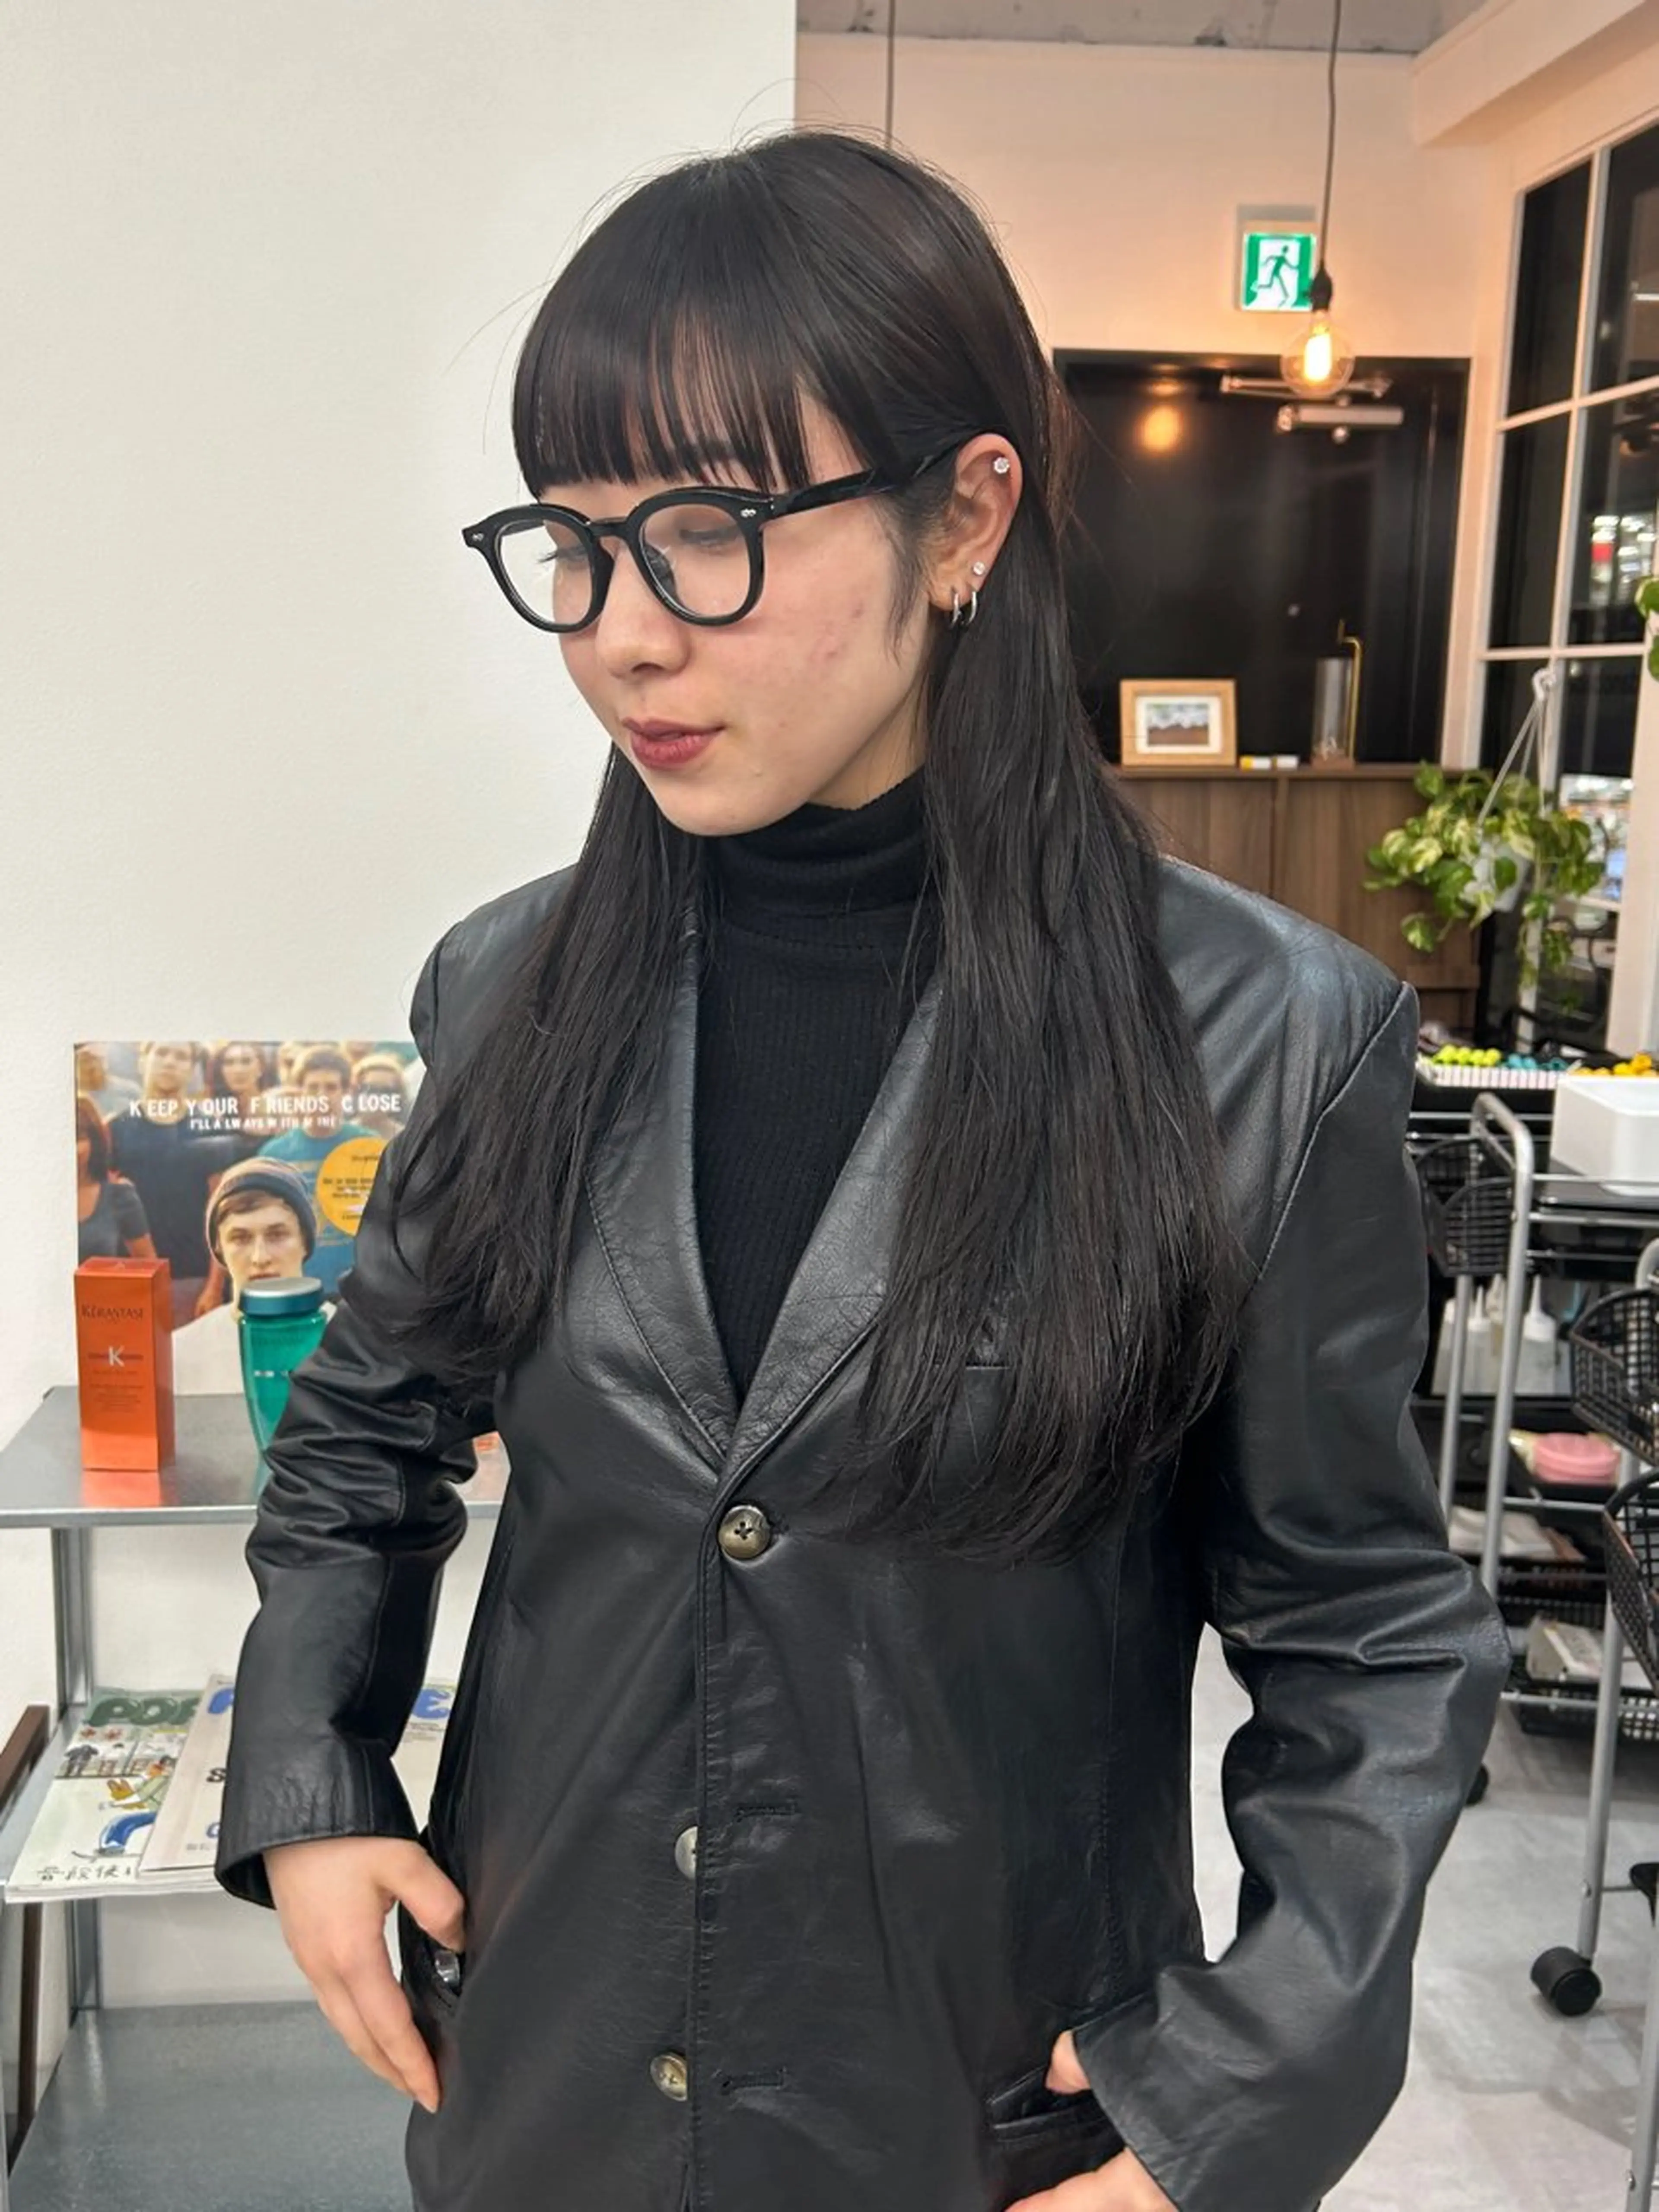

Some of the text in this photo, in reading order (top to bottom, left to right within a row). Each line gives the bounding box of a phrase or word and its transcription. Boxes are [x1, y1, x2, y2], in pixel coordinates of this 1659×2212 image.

[130, 1093, 402, 1118] KEEP YOUR FRIENDS CLOSE
[108, 1345, 126, 1368] K
